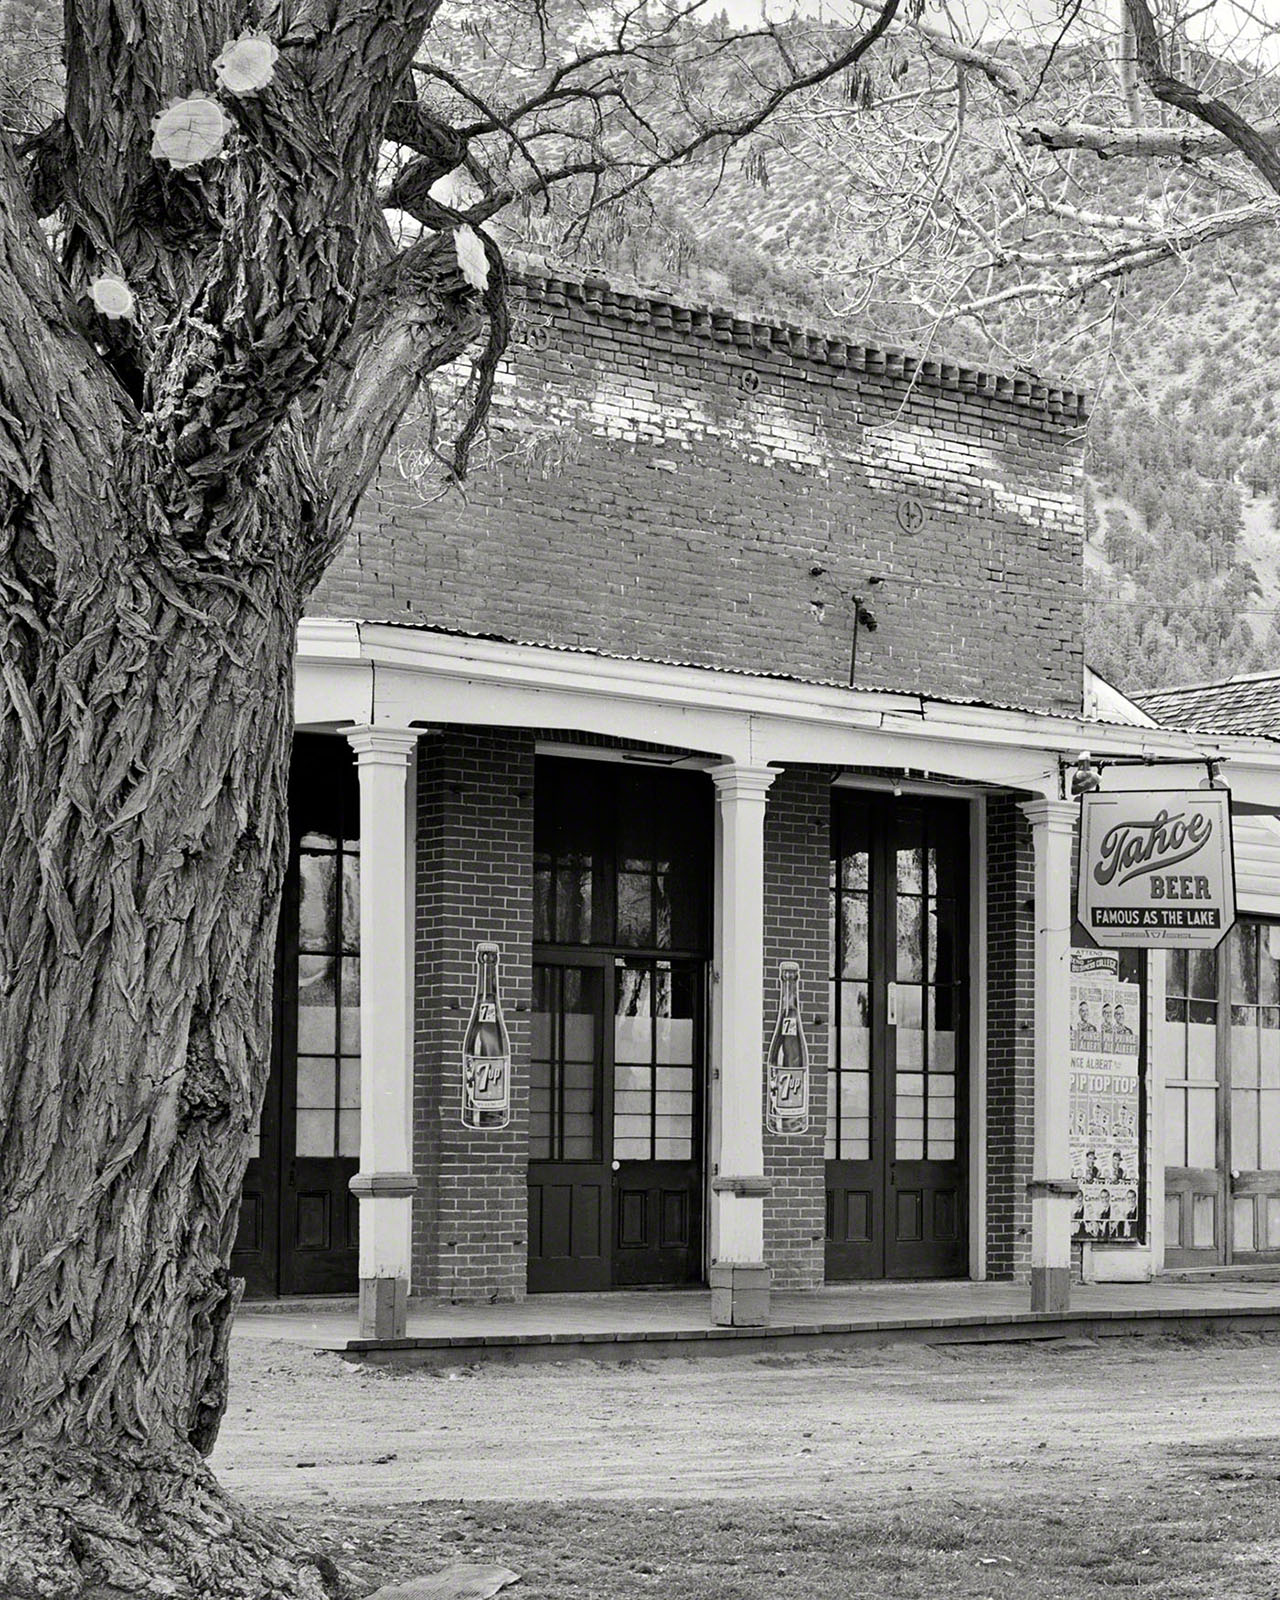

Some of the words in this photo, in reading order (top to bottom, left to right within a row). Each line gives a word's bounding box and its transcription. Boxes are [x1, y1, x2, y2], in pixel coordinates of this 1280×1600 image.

[1093, 809, 1213, 887] Tahoe
[1149, 875, 1212, 900] BEER
[1095, 909, 1140, 925] FAMOUS
[1143, 911, 1158, 925] AS
[1162, 911, 1183, 925] THE
[1186, 912, 1215, 926] LAKE
[1086, 1057, 1113, 1070] ALBERT
[1089, 1075, 1111, 1093] TOP
[1114, 1076, 1137, 1094] TOP
